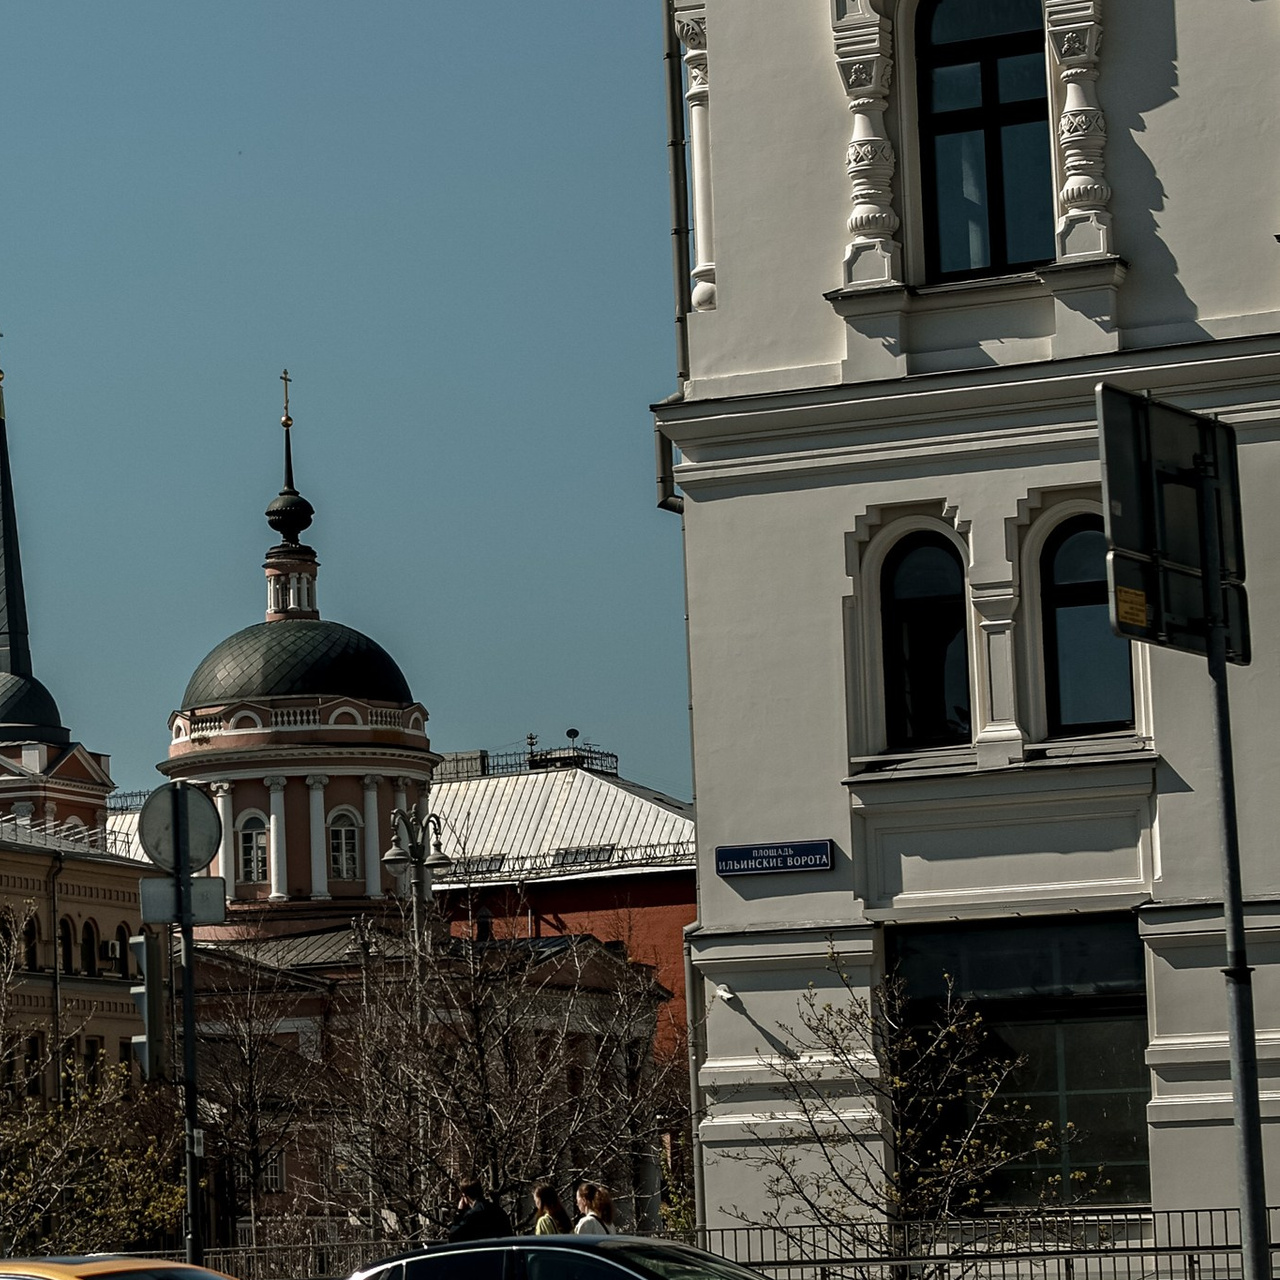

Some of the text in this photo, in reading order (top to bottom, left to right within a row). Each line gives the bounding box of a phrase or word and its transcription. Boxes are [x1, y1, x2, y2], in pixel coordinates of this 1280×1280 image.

[752, 847, 794, 857] ПЛОЩАДЬ
[718, 855, 828, 870] ИЛЬИНСКИЕ ВОРОТА
